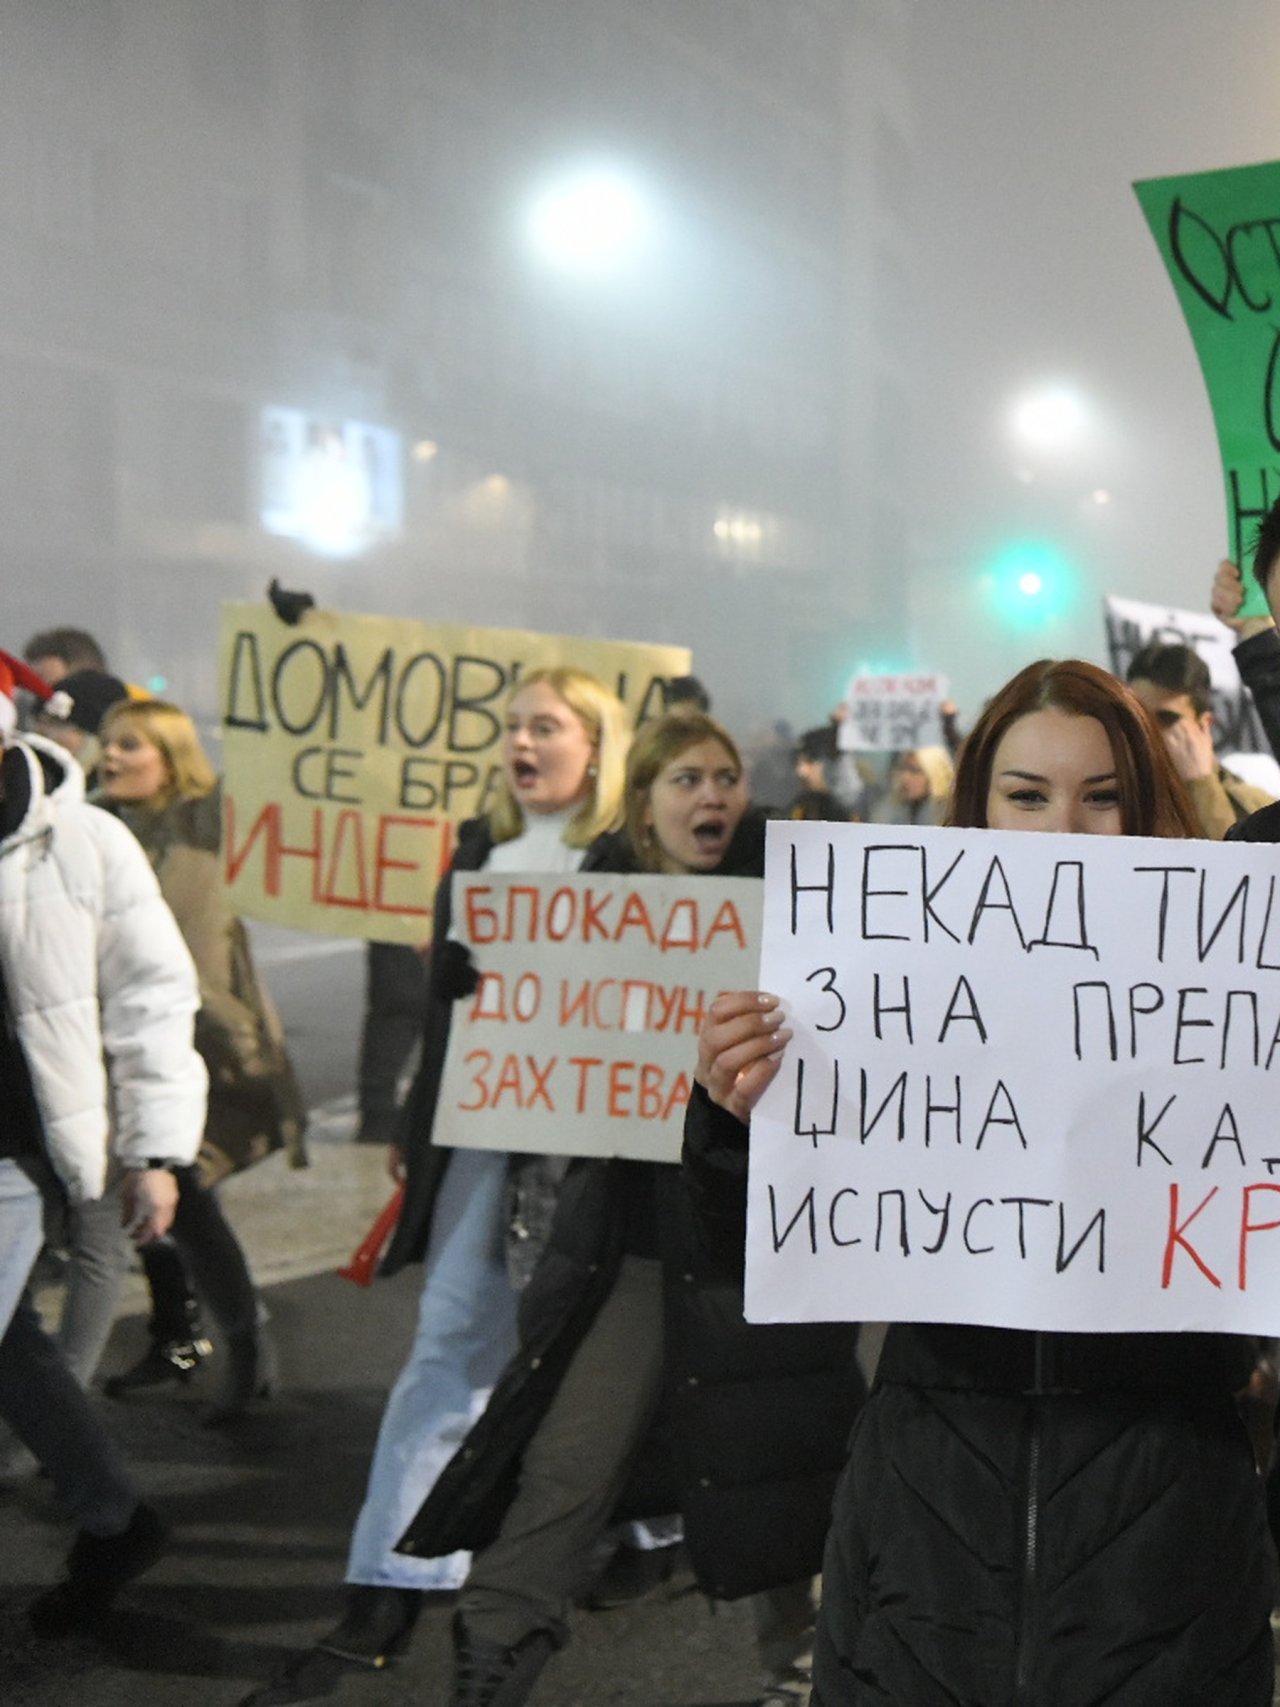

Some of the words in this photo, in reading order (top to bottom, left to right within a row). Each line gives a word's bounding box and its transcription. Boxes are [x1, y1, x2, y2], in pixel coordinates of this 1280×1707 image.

[291, 745, 364, 805] СЕ
[464, 884, 748, 952] БЛОКАДА
[789, 843, 1100, 962] НЕКАД
[468, 967, 542, 1026] ДО
[805, 966, 989, 1045] ЗНА
[767, 1183, 1106, 1274] ИСПУСТИ
